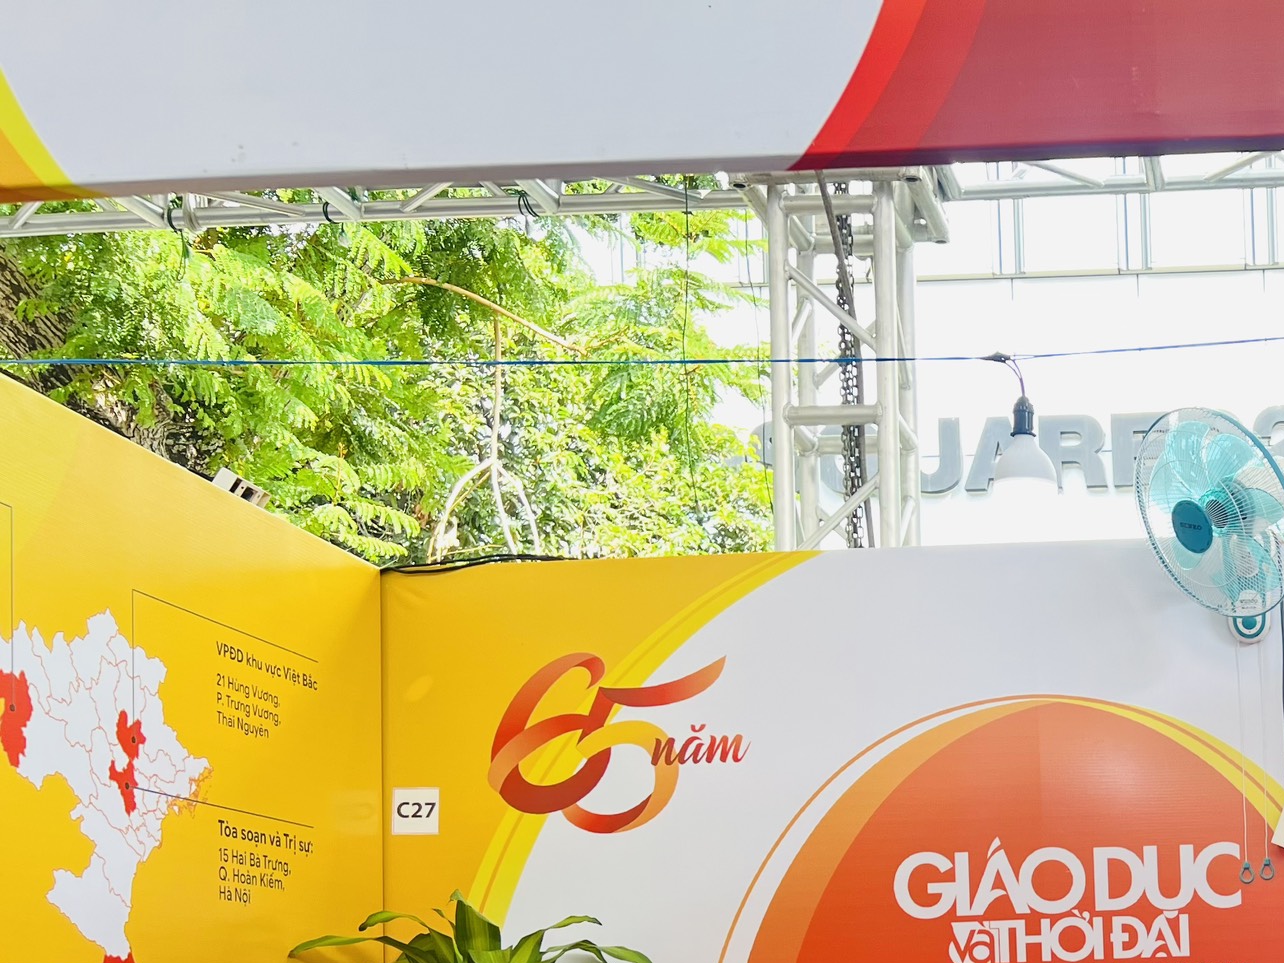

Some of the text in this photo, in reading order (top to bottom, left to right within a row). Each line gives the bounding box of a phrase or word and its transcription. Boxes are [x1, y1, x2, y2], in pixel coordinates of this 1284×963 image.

[216, 641, 318, 691] VPĐD khu vực Việt Bắc
[650, 723, 752, 767] năm
[396, 801, 437, 818] C27
[218, 819, 314, 857] Tòa soạn và Trị sự:
[219, 848, 292, 877] 15 Hai Bà Trưng,
[893, 836, 1242, 919] GIÁO DỤC
[990, 909, 1104, 963] THỜI
[1109, 910, 1191, 959] ĐẠI
